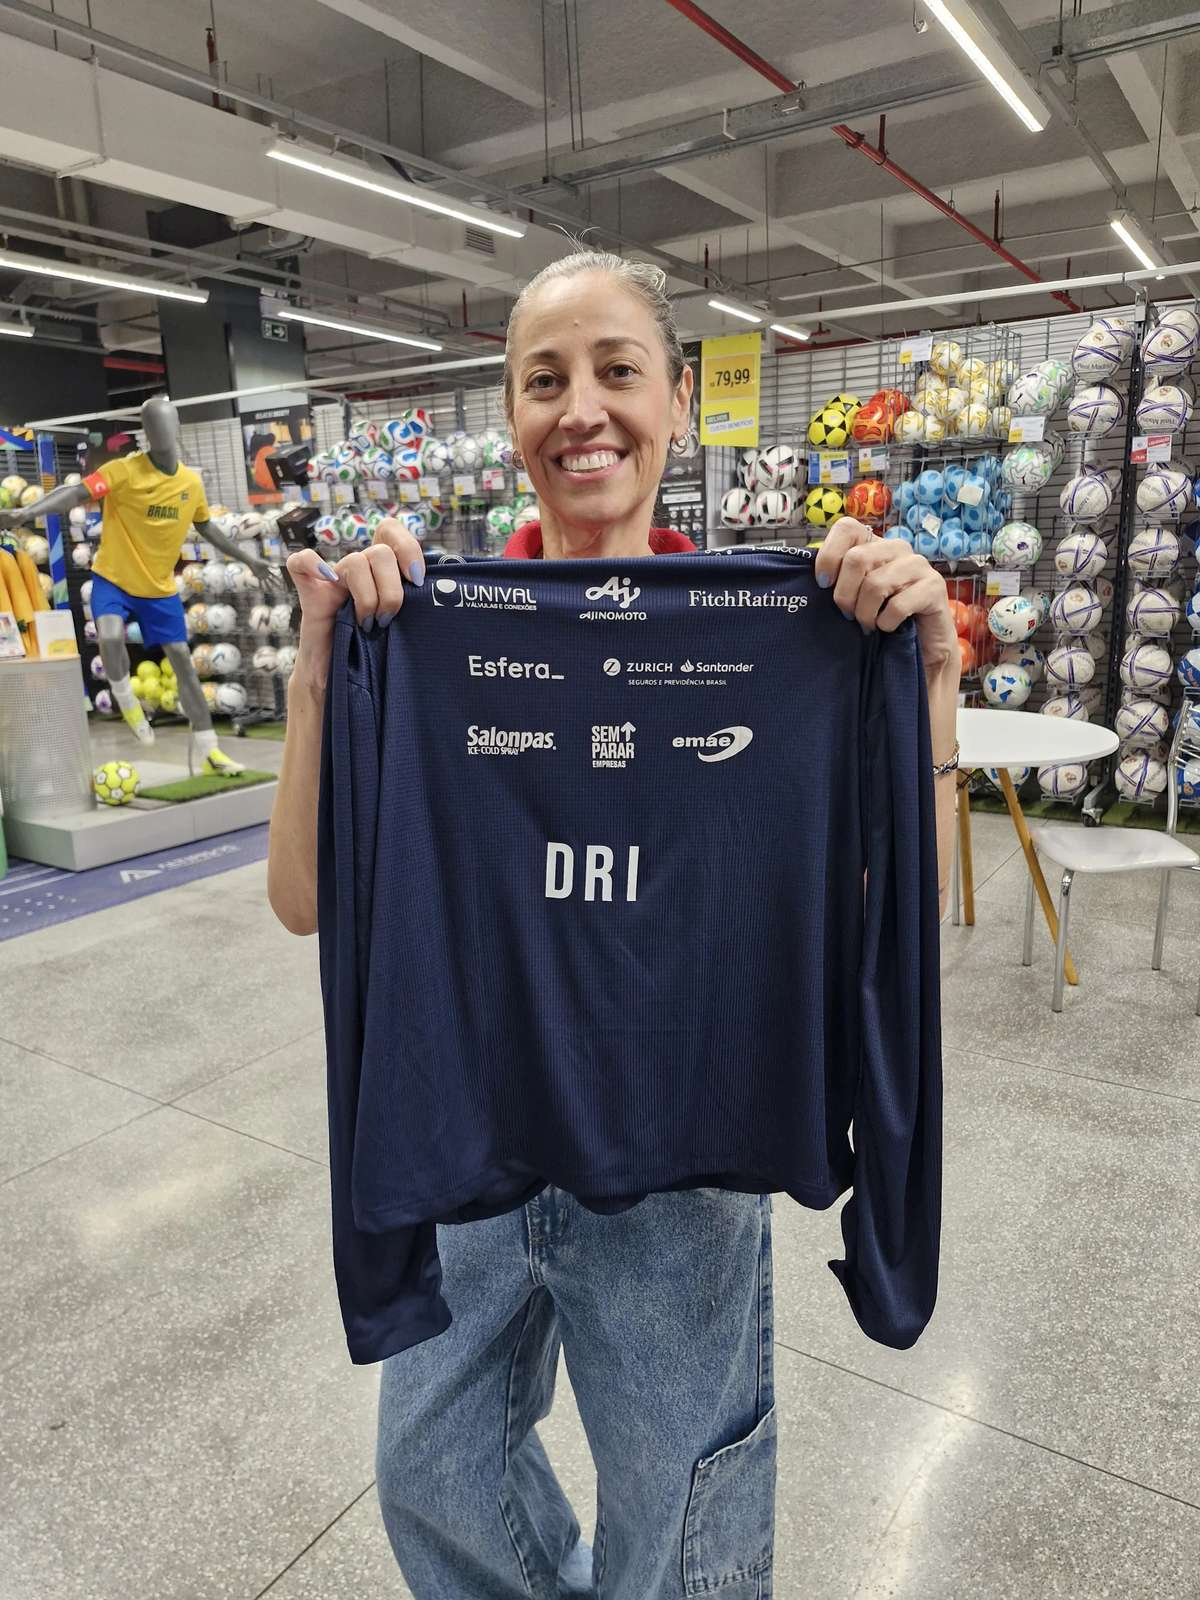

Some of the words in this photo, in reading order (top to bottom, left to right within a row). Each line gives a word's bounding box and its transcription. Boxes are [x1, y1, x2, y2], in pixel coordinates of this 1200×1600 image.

[147, 504, 179, 520] BRASIL
[463, 584, 537, 604] UNIVAL
[498, 602, 503, 610] E
[579, 611, 647, 621] AJINOMOTO
[626, 662, 673, 673] ZURICH
[696, 661, 755, 673] Santander
[591, 725, 620, 743] SEM
[672, 735, 731, 748] emae
[591, 742, 635, 759] PARAR
[592, 760, 626, 768] EMPRESAS
[545, 841, 640, 902] DRI
